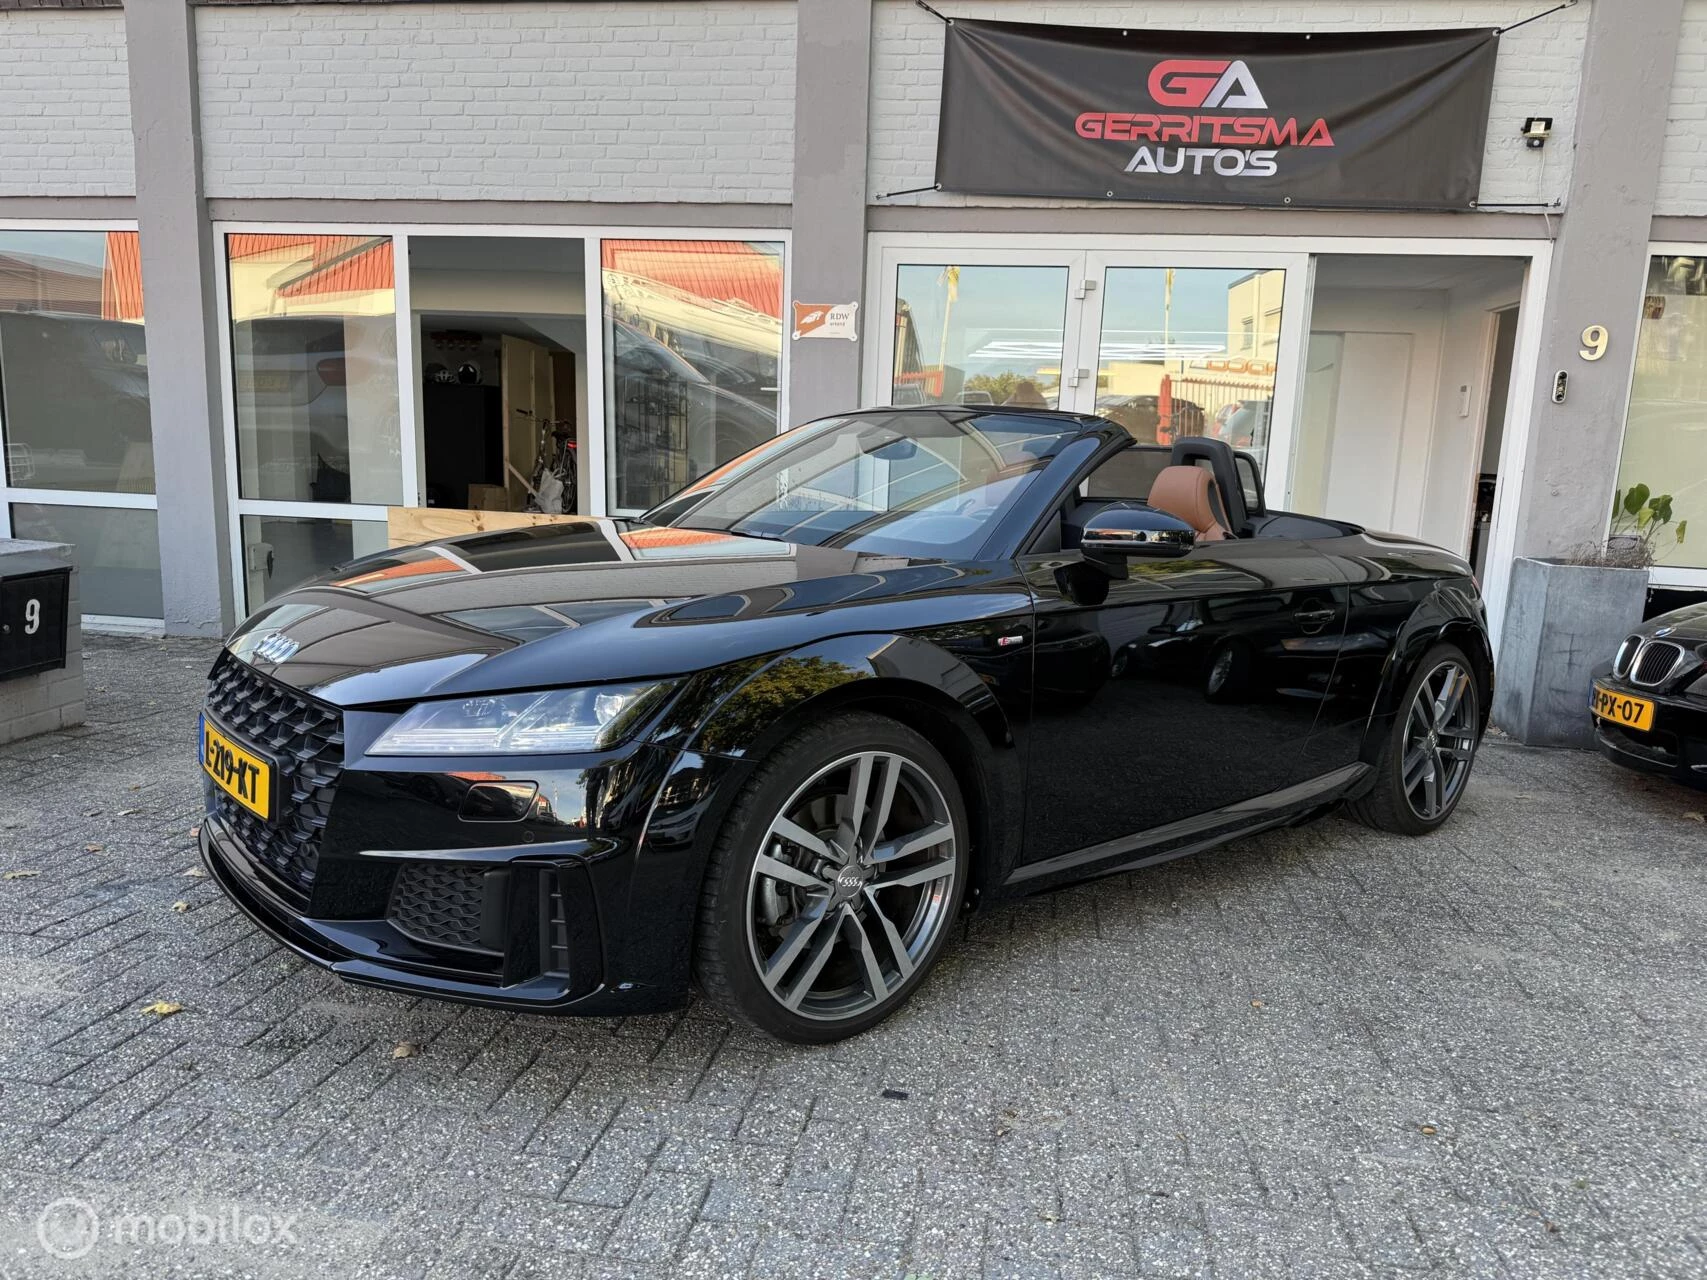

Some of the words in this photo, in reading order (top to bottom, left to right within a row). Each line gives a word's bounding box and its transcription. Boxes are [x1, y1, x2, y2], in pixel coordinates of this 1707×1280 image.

[1074, 112, 1336, 147] GERRITSMA
[1123, 145, 1279, 177] AUTO'S
[1578, 325, 1609, 361] 9
[24, 598, 41, 635] 9
[205, 731, 260, 804] L-219-KT
